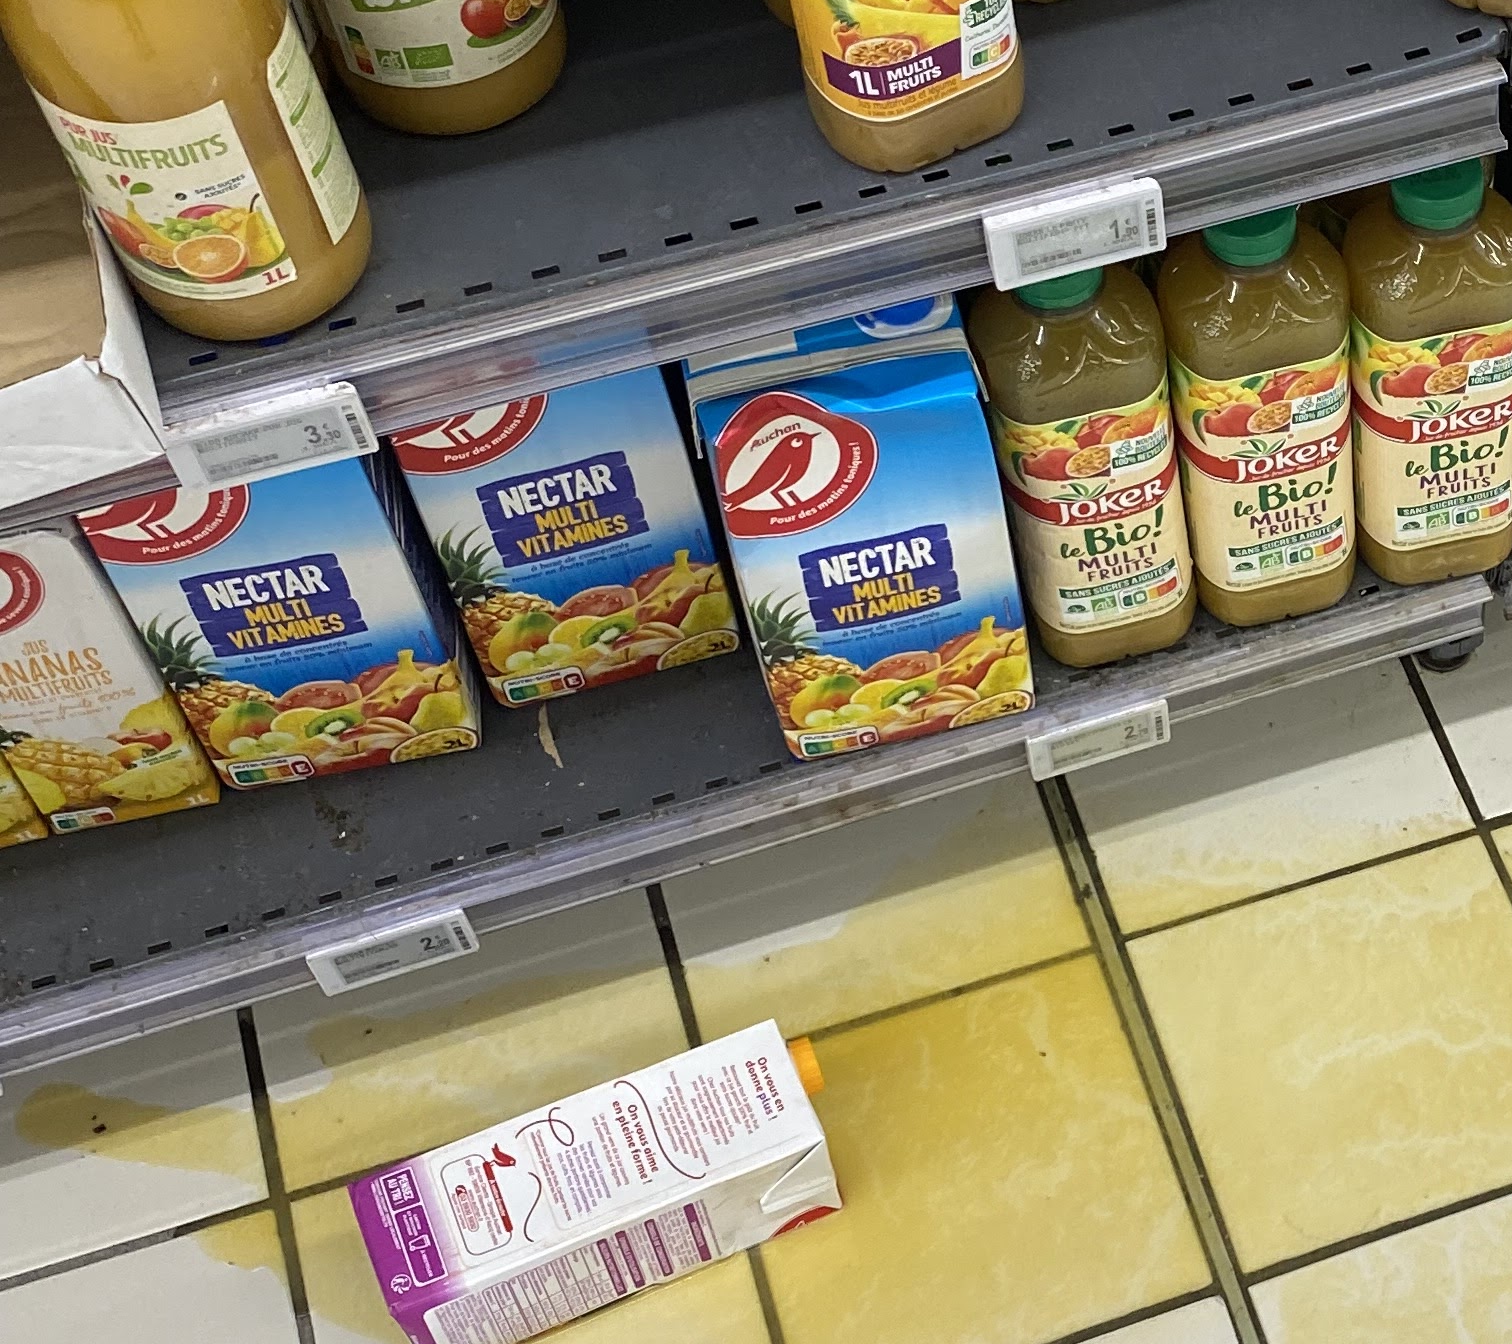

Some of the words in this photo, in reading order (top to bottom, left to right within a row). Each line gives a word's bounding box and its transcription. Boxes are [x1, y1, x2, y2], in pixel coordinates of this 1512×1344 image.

[849, 70, 880, 96] 1L
[887, 55, 935, 82] MULTI
[888, 65, 943, 95] FRUITS
[67, 131, 229, 170] MULTIFRUITS
[89, 128, 118, 146] JUS
[261, 266, 291, 286] 1L
[749, 421, 802, 453] Auchan
[1408, 400, 1512, 444] JOKER
[443, 450, 471, 464] Pour
[471, 441, 491, 457] des
[490, 419, 520, 446] matins
[1404, 459, 1430, 479] le
[1429, 424, 1510, 473] Bio!
[1234, 435, 1341, 484] JOKER
[1419, 461, 1497, 490] MULTI
[496, 463, 618, 520] NECTAR
[769, 514, 797, 526] Pour
[797, 505, 818, 520] des
[816, 483, 850, 512] matins
[842, 443, 864, 486] toniques
[1233, 500, 1258, 519] le
[1257, 460, 1339, 513] Bio!
[1426, 475, 1492, 500] FRUITS
[533, 500, 599, 533] MULTI
[1059, 478, 1167, 526] JOKER
[1249, 499, 1327, 531] MULTI
[1402, 505, 1429, 517] SANS
[1429, 497, 1465, 513] SUCRES
[515, 513, 630, 559] VITAMINES
[1060, 542, 1086, 560] le
[1083, 502, 1165, 558] Bio!
[1257, 514, 1324, 540] FRUITS
[1078, 542, 1158, 573] MULTI
[1234, 545, 1262, 557] SANS
[1261, 535, 1299, 553] SUCRES
[817, 536, 937, 589] NECTAR
[1087, 556, 1155, 583] FRUITS
[201, 563, 331, 612] NECTAR
[851, 572, 916, 603] MULTI
[1065, 587, 1093, 599] SANS
[1093, 578, 1131, 596] SUCRES
[243, 598, 313, 628] MULTI
[832, 586, 943, 625] VITAMINES
[23, 639, 50, 657] JUS
[226, 613, 346, 651] VITAMINES
[744, 1059, 763, 1093] donne
[754, 1091, 774, 1117] plus
[755, 1056, 769, 1073] On
[762, 1072, 779, 1098] vous
[773, 1098, 785, 1112] en
[611, 1100, 622, 1115] en
[614, 1114, 638, 1150] pleine
[626, 1103, 640, 1121] On
[633, 1120, 650, 1147] vous
[643, 1146, 660, 1173] aime
[630, 1148, 649, 1180] forme
[396, 1173, 414, 1202] PENSEZ
